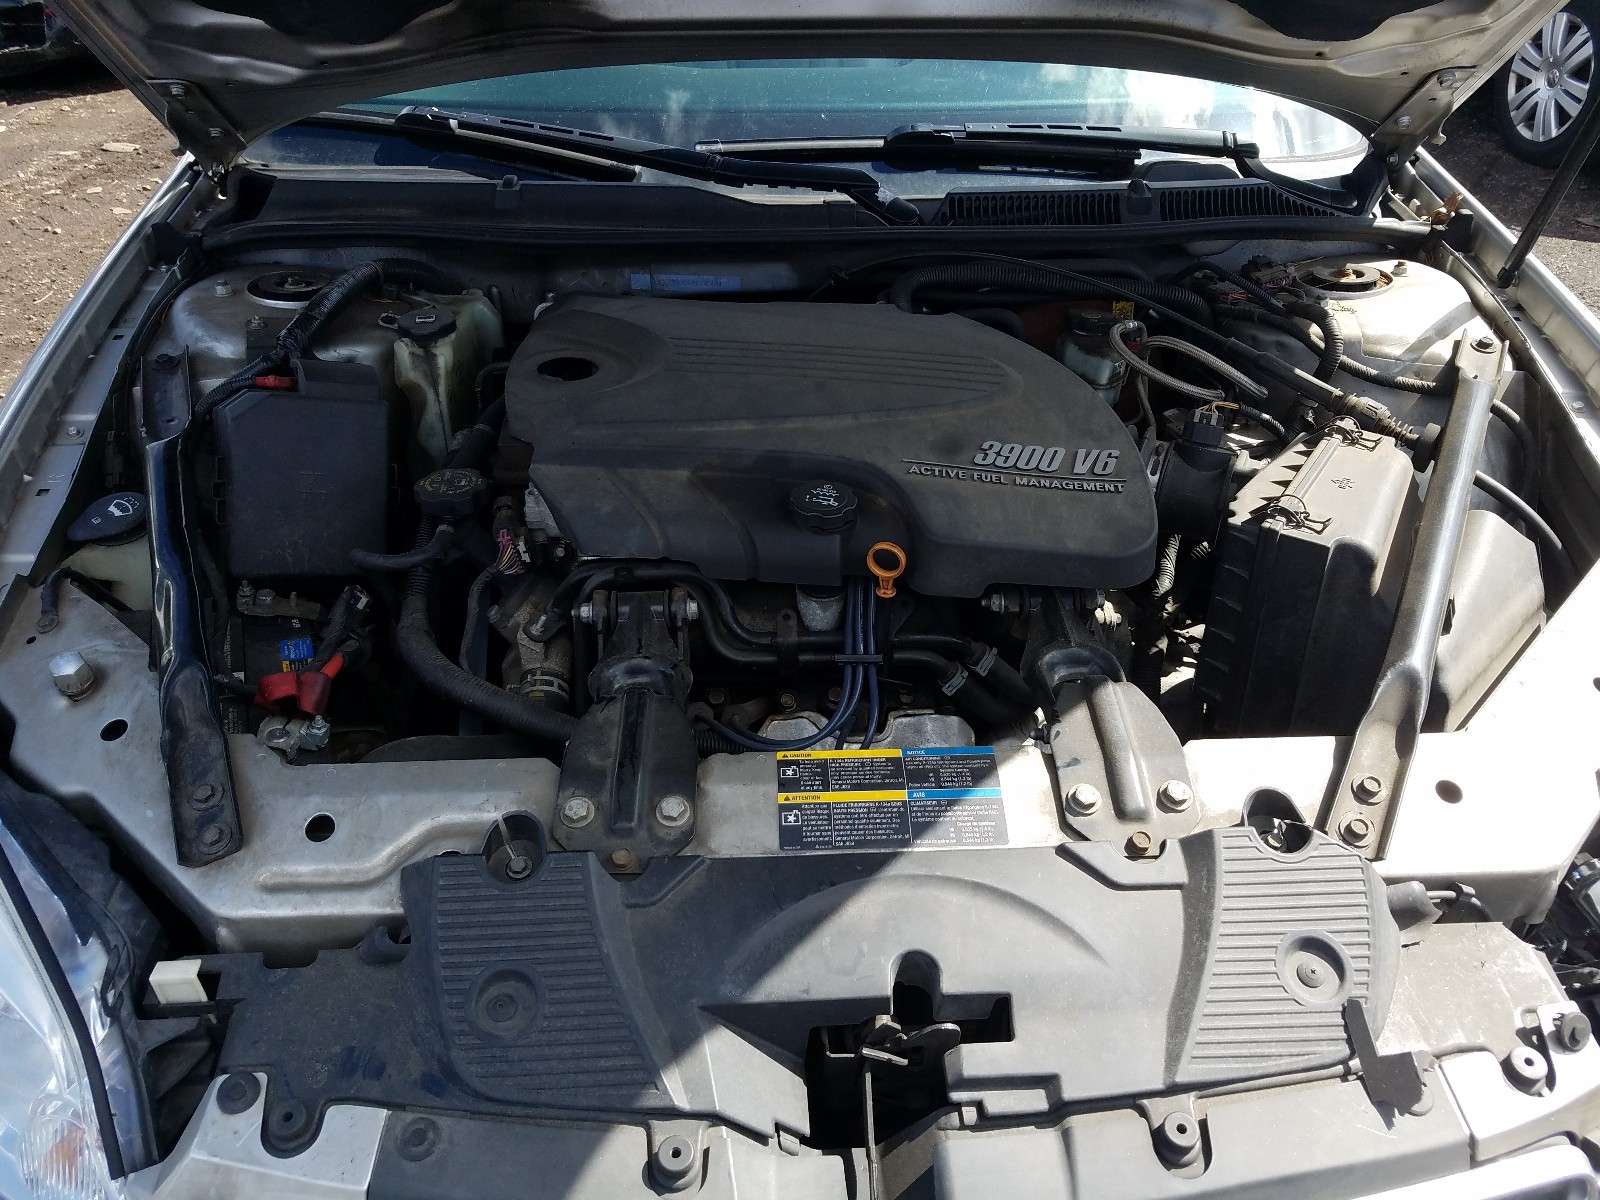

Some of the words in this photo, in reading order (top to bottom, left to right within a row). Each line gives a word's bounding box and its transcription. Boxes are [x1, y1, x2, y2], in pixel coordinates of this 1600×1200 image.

[973, 441, 1066, 472] 3900
[1073, 447, 1121, 476] V6
[908, 464, 966, 479] ACTIVE
[973, 472, 1009, 485] FUEL
[1015, 475, 1125, 493] MANAGEMENT
